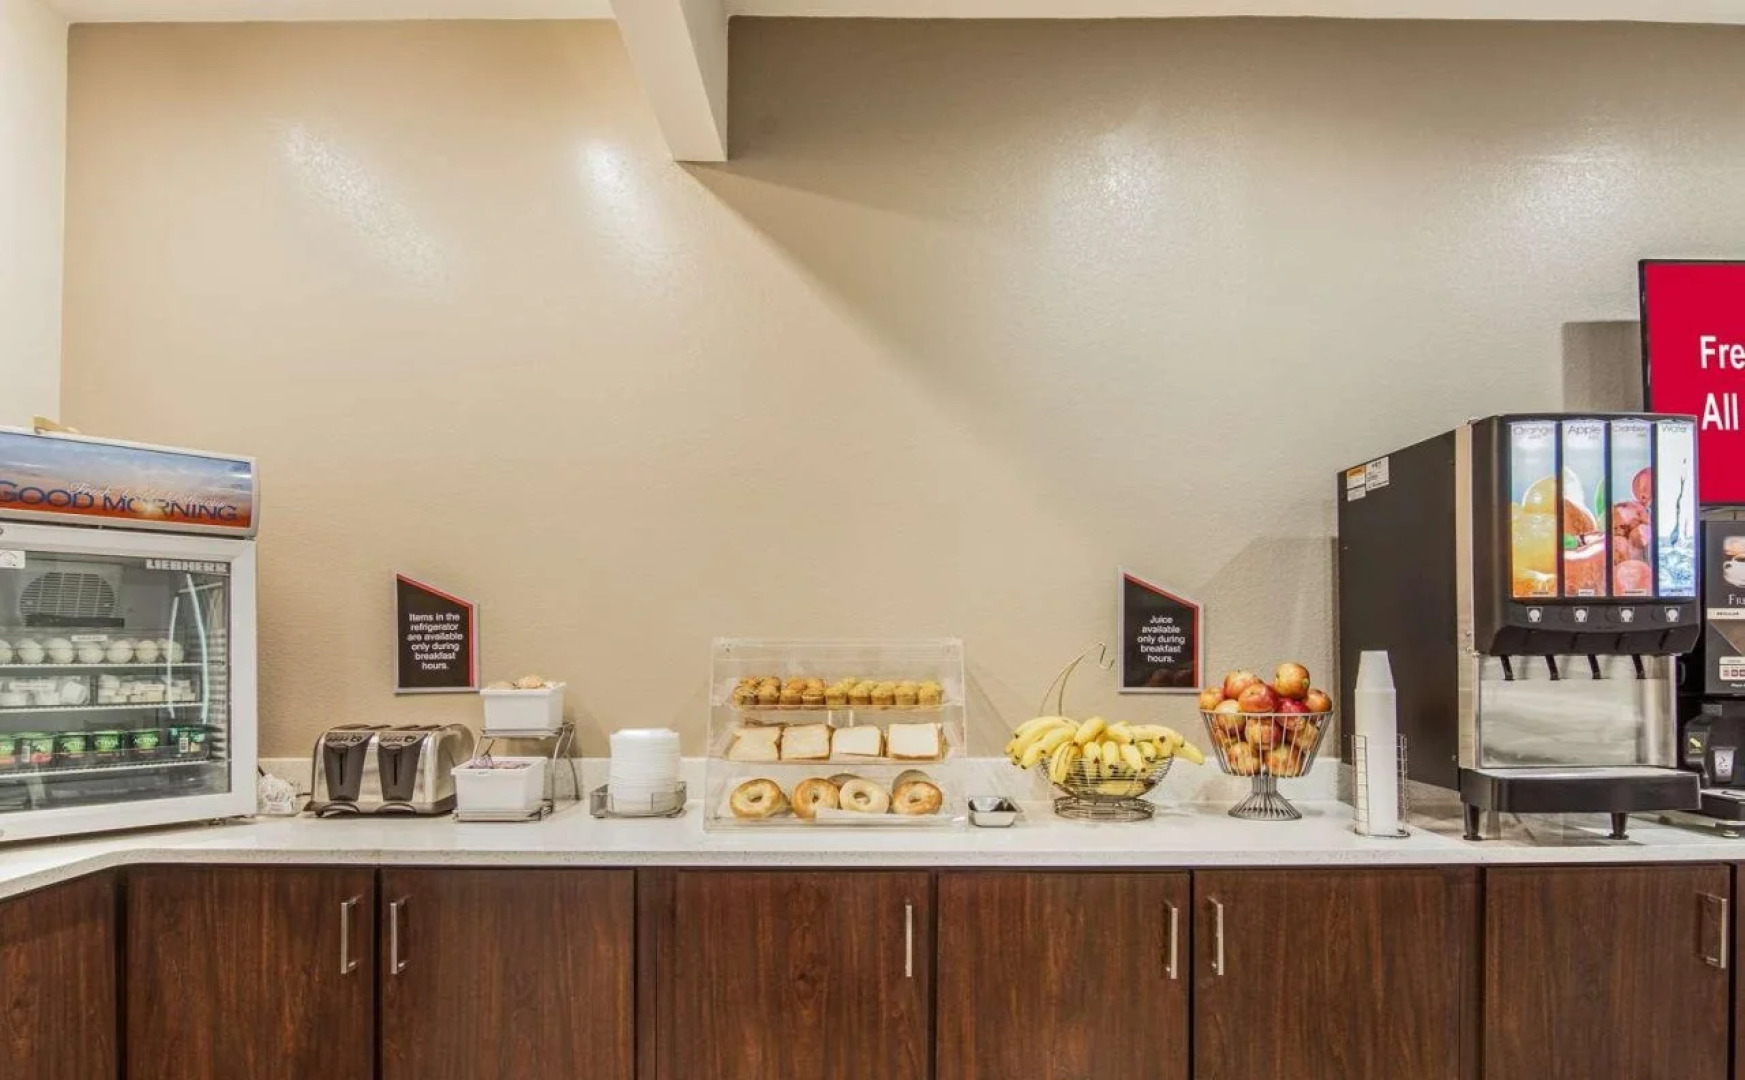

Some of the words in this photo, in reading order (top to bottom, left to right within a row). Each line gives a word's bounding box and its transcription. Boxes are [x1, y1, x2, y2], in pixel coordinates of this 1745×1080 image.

[1700, 335, 1745, 369] Fre
[1702, 392, 1739, 431] All
[1568, 425, 1602, 436] Apple
[0, 480, 95, 508] GOOD
[102, 494, 238, 522] MORNING
[409, 613, 434, 621] Items
[435, 613, 444, 621] in
[446, 613, 460, 621] the
[1150, 615, 1173, 624] Juice
[410, 623, 459, 632] refrigerator
[1142, 625, 1180, 634] available
[424, 632, 463, 641] available
[1137, 635, 1156, 644] only
[1158, 635, 1186, 645] during
[411, 643, 430, 652] only
[432, 642, 460, 652] during
[1140, 645, 1181, 653] breakfast
[415, 652, 456, 660] breakfast
[422, 662, 449, 670] hours.
